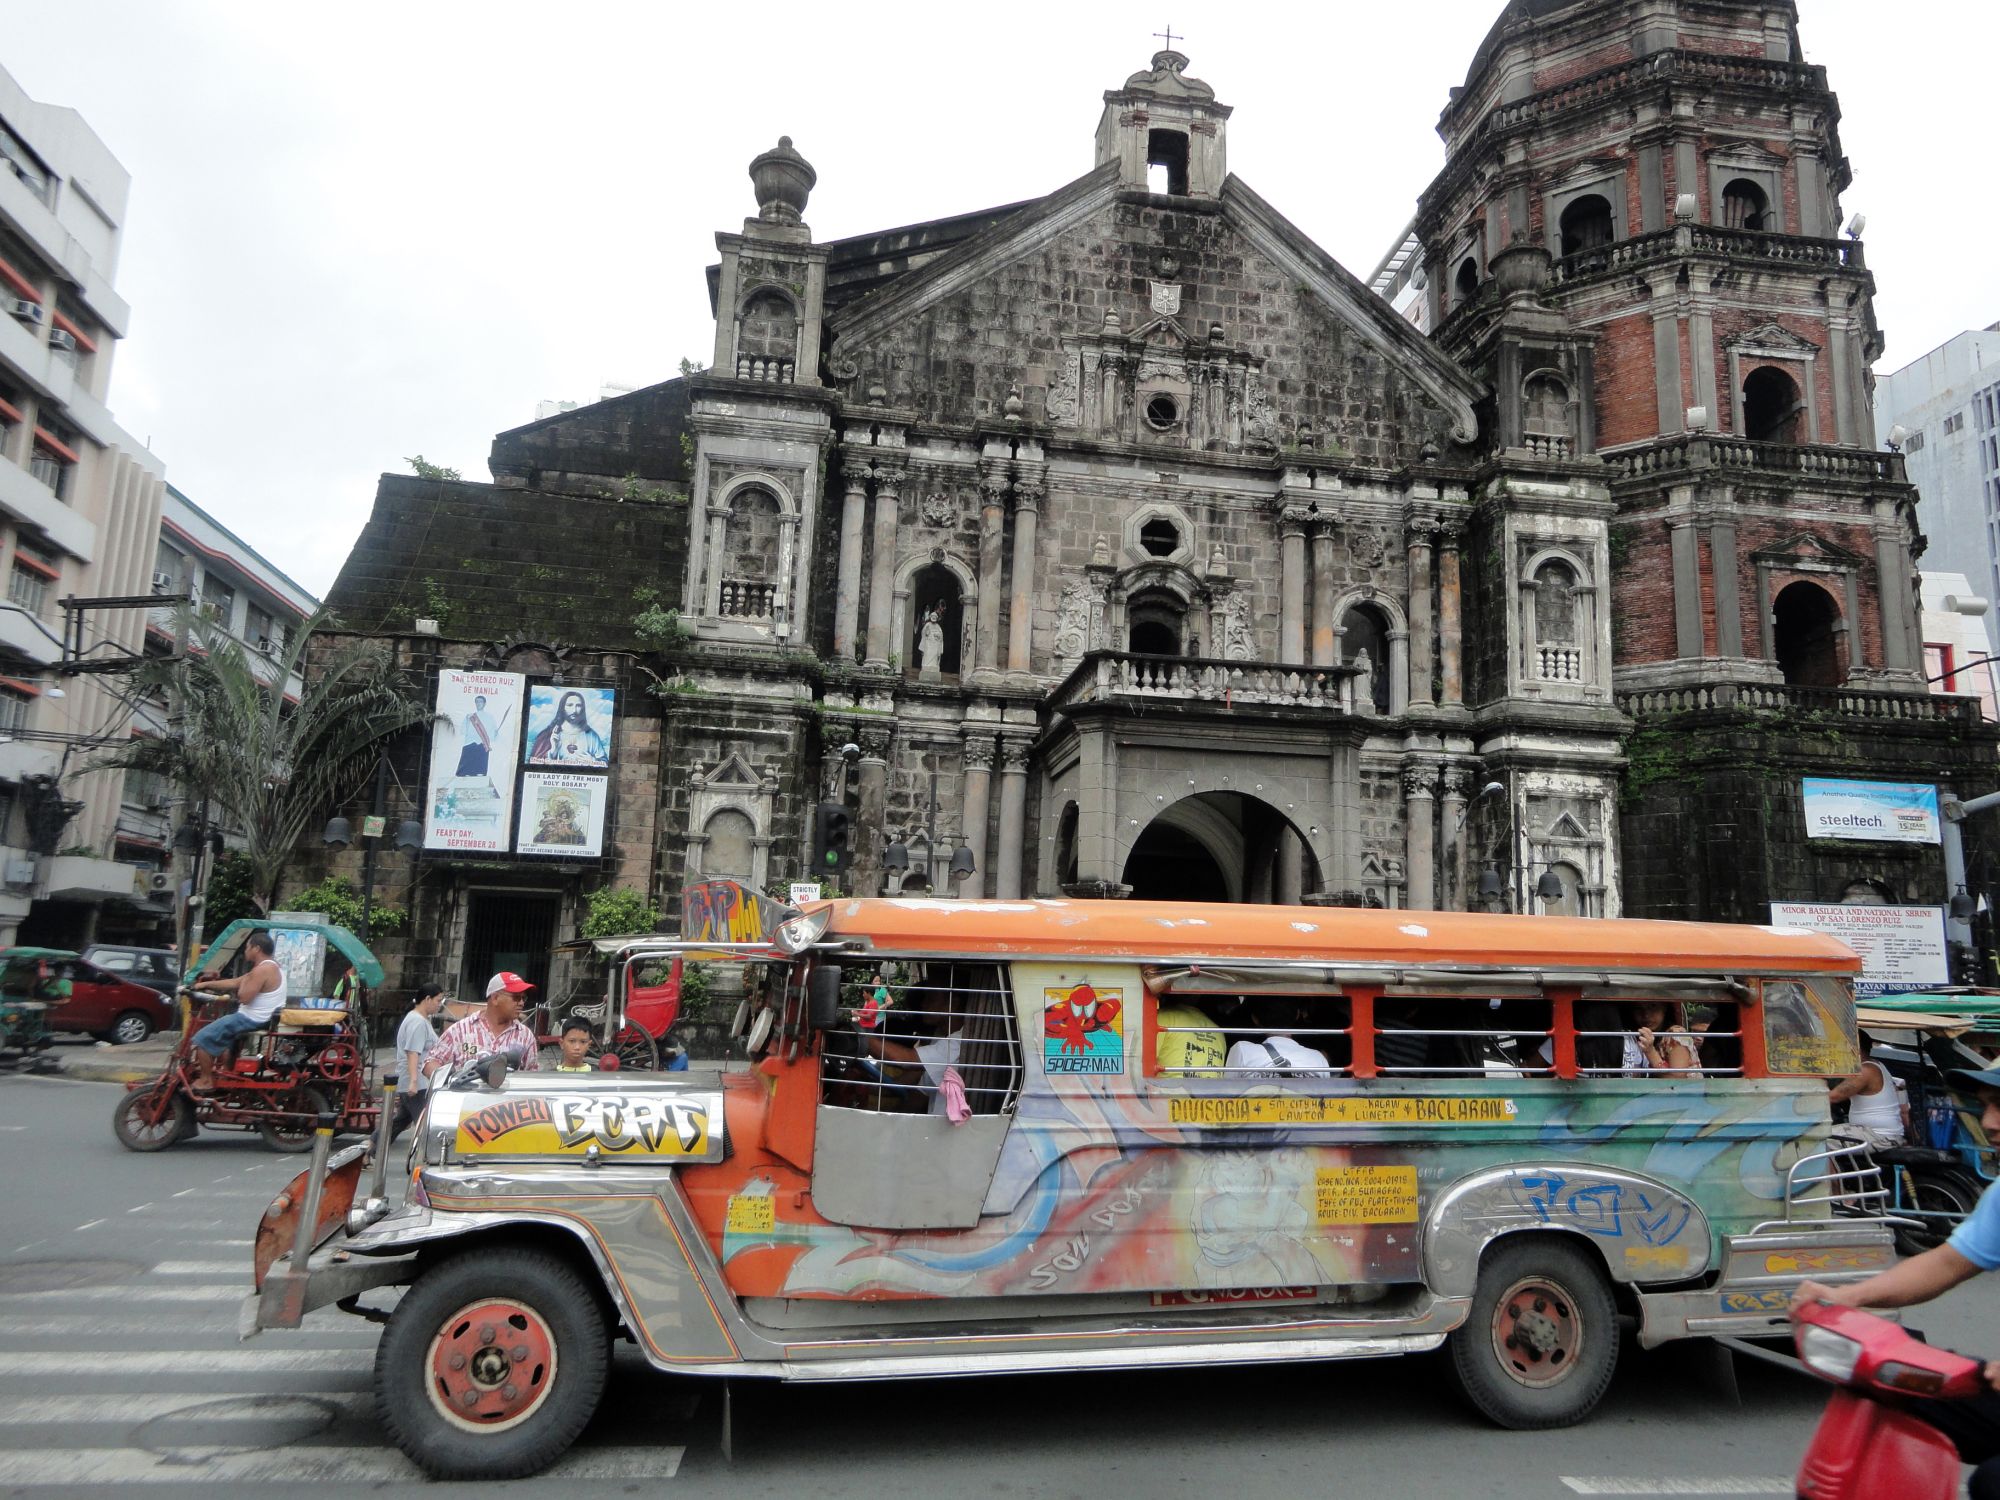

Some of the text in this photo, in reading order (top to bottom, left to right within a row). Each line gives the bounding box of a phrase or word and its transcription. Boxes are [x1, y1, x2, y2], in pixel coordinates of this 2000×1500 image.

[467, 675, 497, 684] LORENZO
[499, 677, 514, 686] RUIZ
[474, 687, 498, 695] MANILA
[1820, 814, 1882, 827] steeltech
[436, 829, 474, 838] FEAST DAY:
[447, 839, 496, 849] SEPTEMBER 28
[1782, 906, 1806, 914] MINOR
[1808, 907, 1843, 915] BASILICA
[1290, 1101, 1309, 1110] CITY
[1415, 1099, 1501, 1121] BACLARAN
[1170, 1099, 1249, 1122] DIVISORIA
[463, 1098, 546, 1142] POWER
[1279, 1111, 1324, 1120] LAWTON
[1355, 1111, 1395, 1120] LUNETA
[1338, 1198, 1346, 1206] OF
[1362, 1208, 1406, 1217] BACLARAN
[1029, 1226, 1090, 1290] SON
